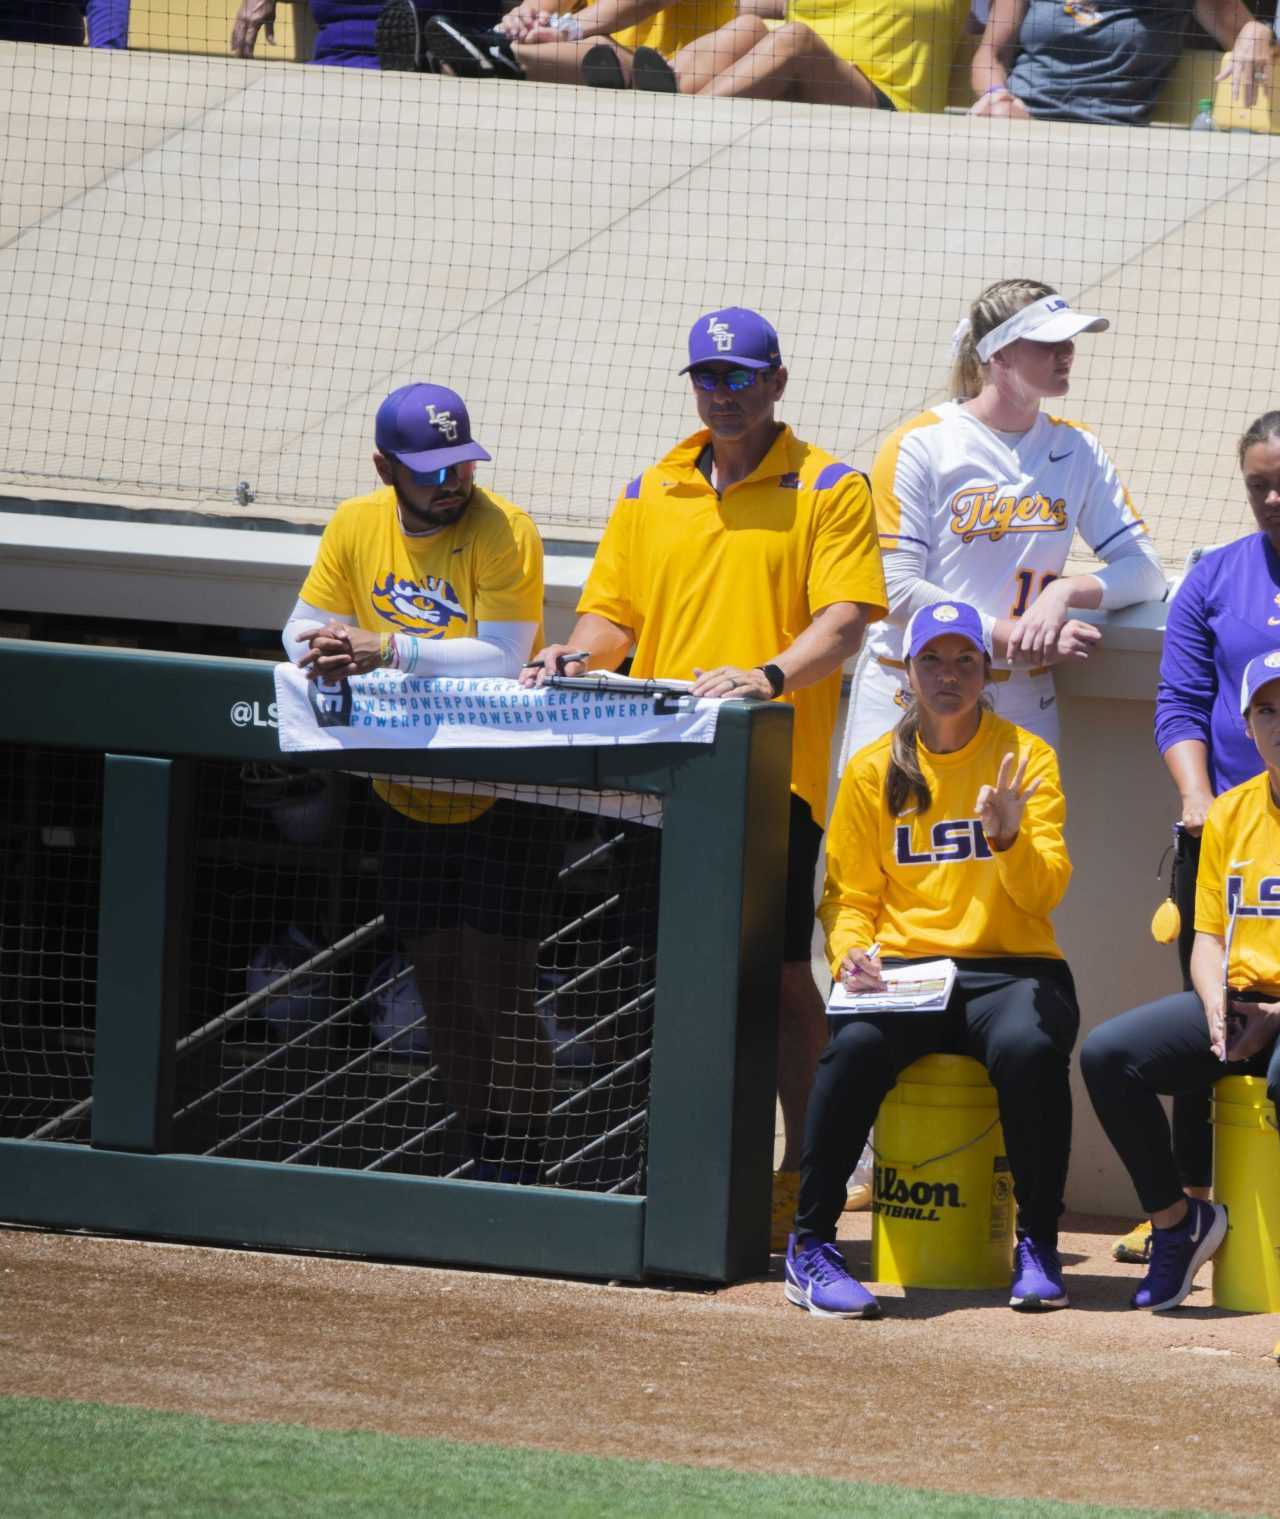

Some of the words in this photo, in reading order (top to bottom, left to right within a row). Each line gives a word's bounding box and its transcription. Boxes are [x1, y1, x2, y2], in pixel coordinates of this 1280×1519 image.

[706, 316, 736, 352] LSU
[425, 404, 458, 441] LSU
[950, 484, 1069, 544] Tigers
[1008, 567, 1060, 622] 1
